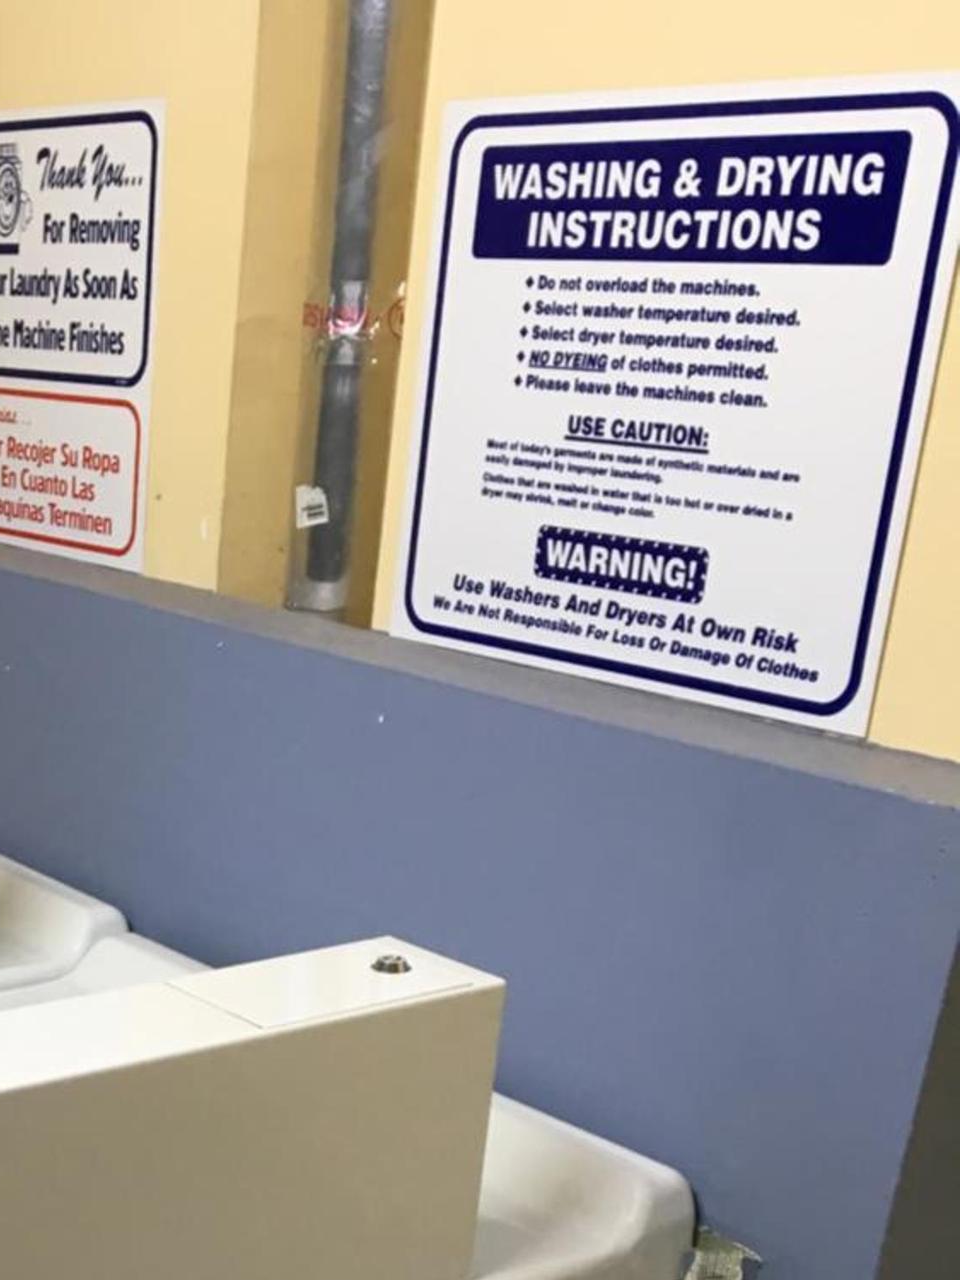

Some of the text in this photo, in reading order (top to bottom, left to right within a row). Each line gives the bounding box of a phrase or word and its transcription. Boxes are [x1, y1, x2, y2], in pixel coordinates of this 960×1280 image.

[37, 144, 142, 201] Thank You...
[493, 153, 886, 200] WASHING & DRYING
[43, 211, 140, 251] For Removing
[527, 209, 822, 251] INSTRUCTIONS
[10, 267, 61, 304] Laundry
[63, 269, 79, 298] As
[82, 269, 117, 300] Soon
[120, 269, 138, 300] As
[538, 275, 760, 297] Do not overload the machines.
[535, 300, 800, 326] Select washer temperature desired.
[13, 319, 65, 351] Machine
[69, 321, 124, 355] Finishes
[532, 325, 778, 354] Select dryer temperature desired.
[529, 350, 768, 380] NO DYEING of clothes permitted.
[525, 374, 768, 408] Please leave the machines clean.
[568, 415, 709, 448] USE CAUTION:
[7, 437, 56, 467] Recojer
[61, 443, 78, 467] Su
[83, 446, 120, 477] Ropa
[485, 454, 662, 484] easily damaged by improper laundering.
[487, 438, 801, 482] Most of today's garments are made of synthetic materials and are
[1, 466, 95, 501] En Cuanto Las
[483, 472, 793, 521] Clothes that are washed in water that is too hot or over dried in a
[49, 503, 112, 535] Terminen
[481, 487, 655, 518] dryer may shrink, melt or change color.
[546, 538, 698, 590] WARNING!
[453, 573, 799, 653] Use Washers And Dryers At Own Risk
[433, 595, 819, 683] We Are Not Responsible For Loss Or Damage Of Clothes
